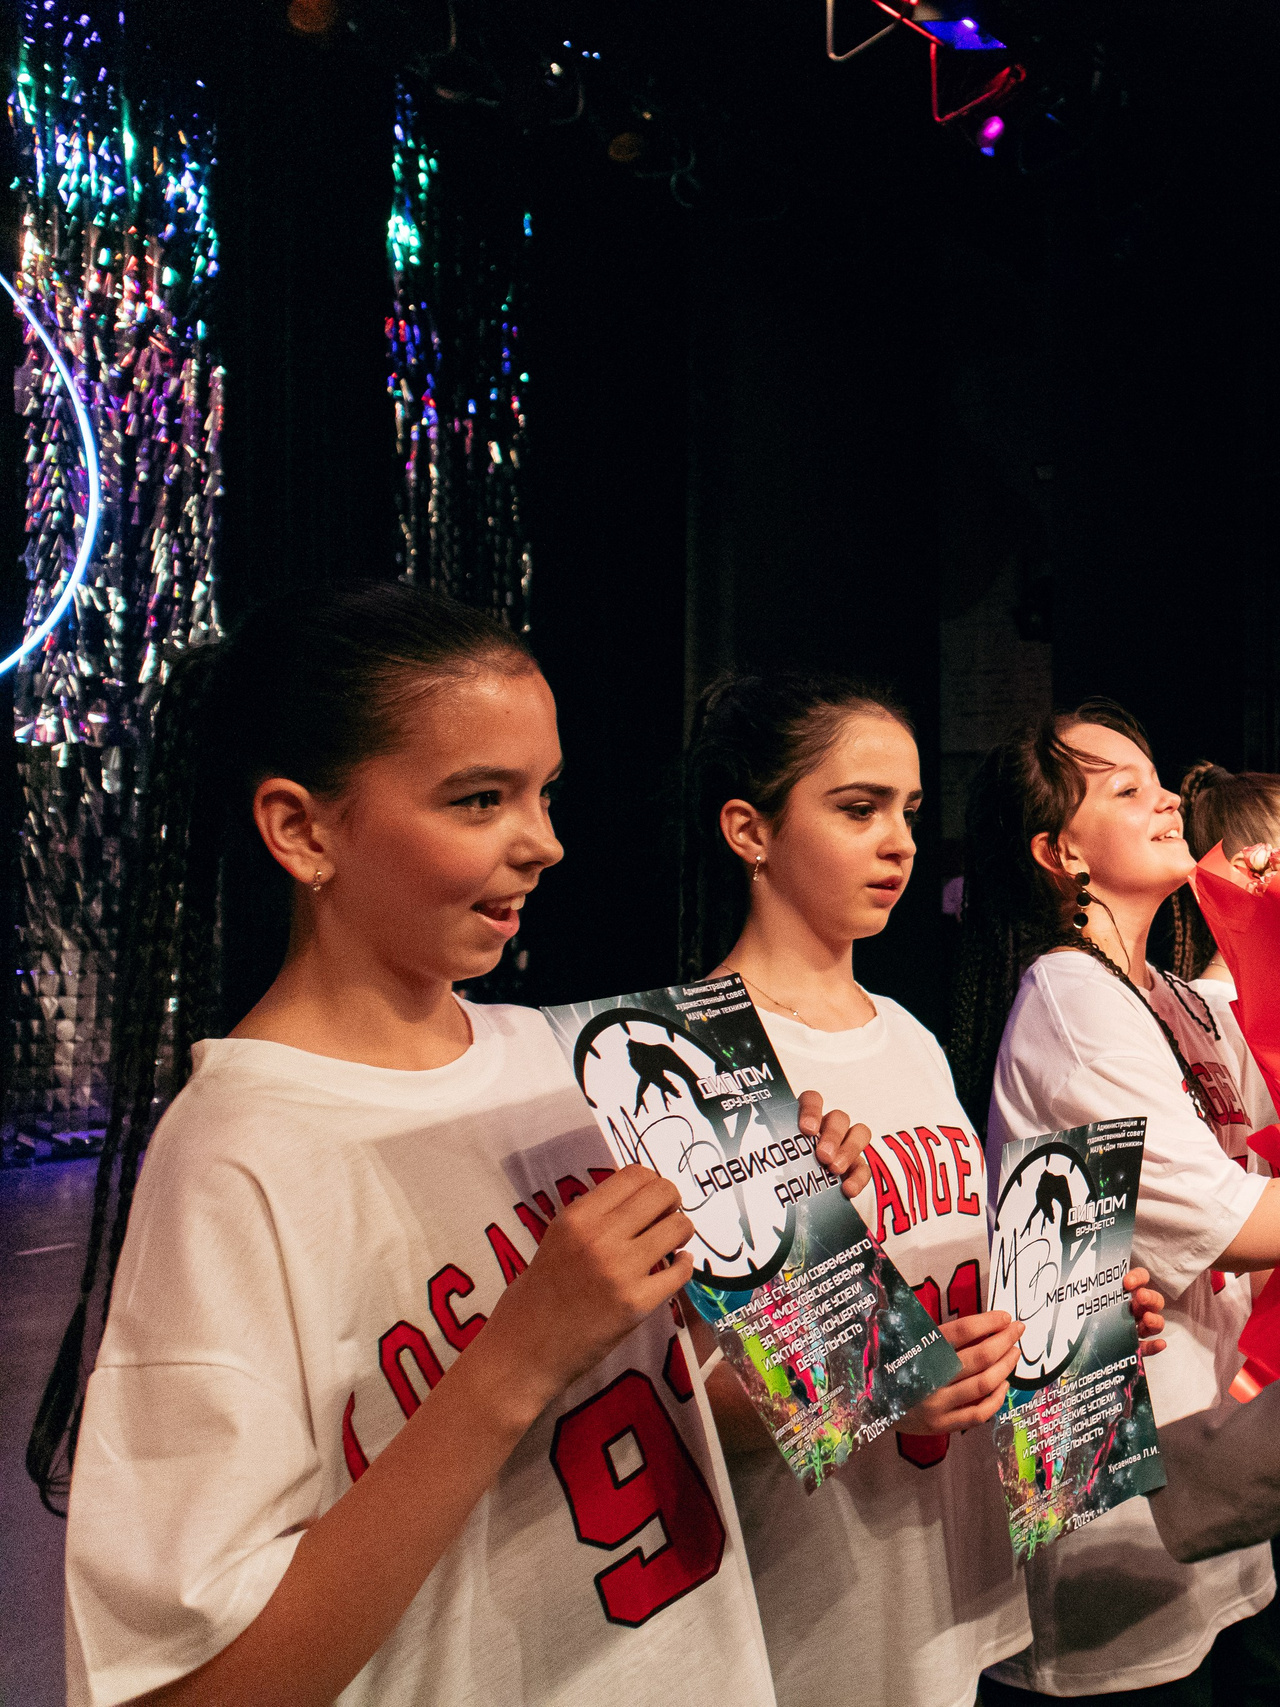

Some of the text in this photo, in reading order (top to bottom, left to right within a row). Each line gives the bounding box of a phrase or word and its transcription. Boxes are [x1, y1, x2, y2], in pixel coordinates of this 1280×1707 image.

[675, 988, 746, 1012] художественный совет
[682, 980, 733, 996] Администрация
[686, 1010, 704, 1021] МАУК
[721, 1001, 752, 1013] техники»
[697, 1063, 774, 1099] ДИПЛОМ
[721, 1088, 772, 1111] ВРУЧАЕТСЯ
[1086, 1130, 1126, 1145] художественный
[1097, 1121, 1137, 1131] Администрация
[1116, 1141, 1143, 1149] техники»
[1067, 1194, 1127, 1226] ДИПЛОМ
[1076, 1217, 1115, 1237] ВРУЧАЕТСЯ
[715, 1239, 871, 1332] УЧАСТНИЦЕ СТУДИИ СОВРЕМЕННОГО
[1046, 1258, 1128, 1307] МЕЛКУМОВОЙ
[737, 1261, 865, 1341] ТАНЦА «МОСКОВСКОЕ ВРЕМЯ»
[760, 1283, 863, 1349] ЗА ТВОРЧЕСКИЕ УСПЕХИ
[1076, 1288, 1132, 1320] РУЗАННЕ
[762, 1294, 876, 1370] И АКТИВНУЮ КОНЦЕРТНУЮ
[795, 1323, 863, 1371] ДЕЯТЕЛЬНОСТЬ
[884, 1330, 942, 1375] Хусаенова Л.И.
[999, 1356, 1137, 1423] УЧАСТНИЦЕ СТУДИИ СОВРЕМЕННОГО
[1013, 1375, 1125, 1431] ТАНЦА «МОСКОВСКОЕ ВРЕМЯ»
[863, 1419, 885, 1442] 2025
[1021, 1404, 1122, 1458] И АКТИВНУЮ КОНЦЕРТНУЮ
[1025, 1393, 1115, 1441] ЗА ТВОРЧЕСКИЕ УСПЕХИ
[1044, 1428, 1104, 1462] ДЕЯТЕЛЬНОСТЬ
[1108, 1445, 1160, 1474] Хусаенова Л.И.
